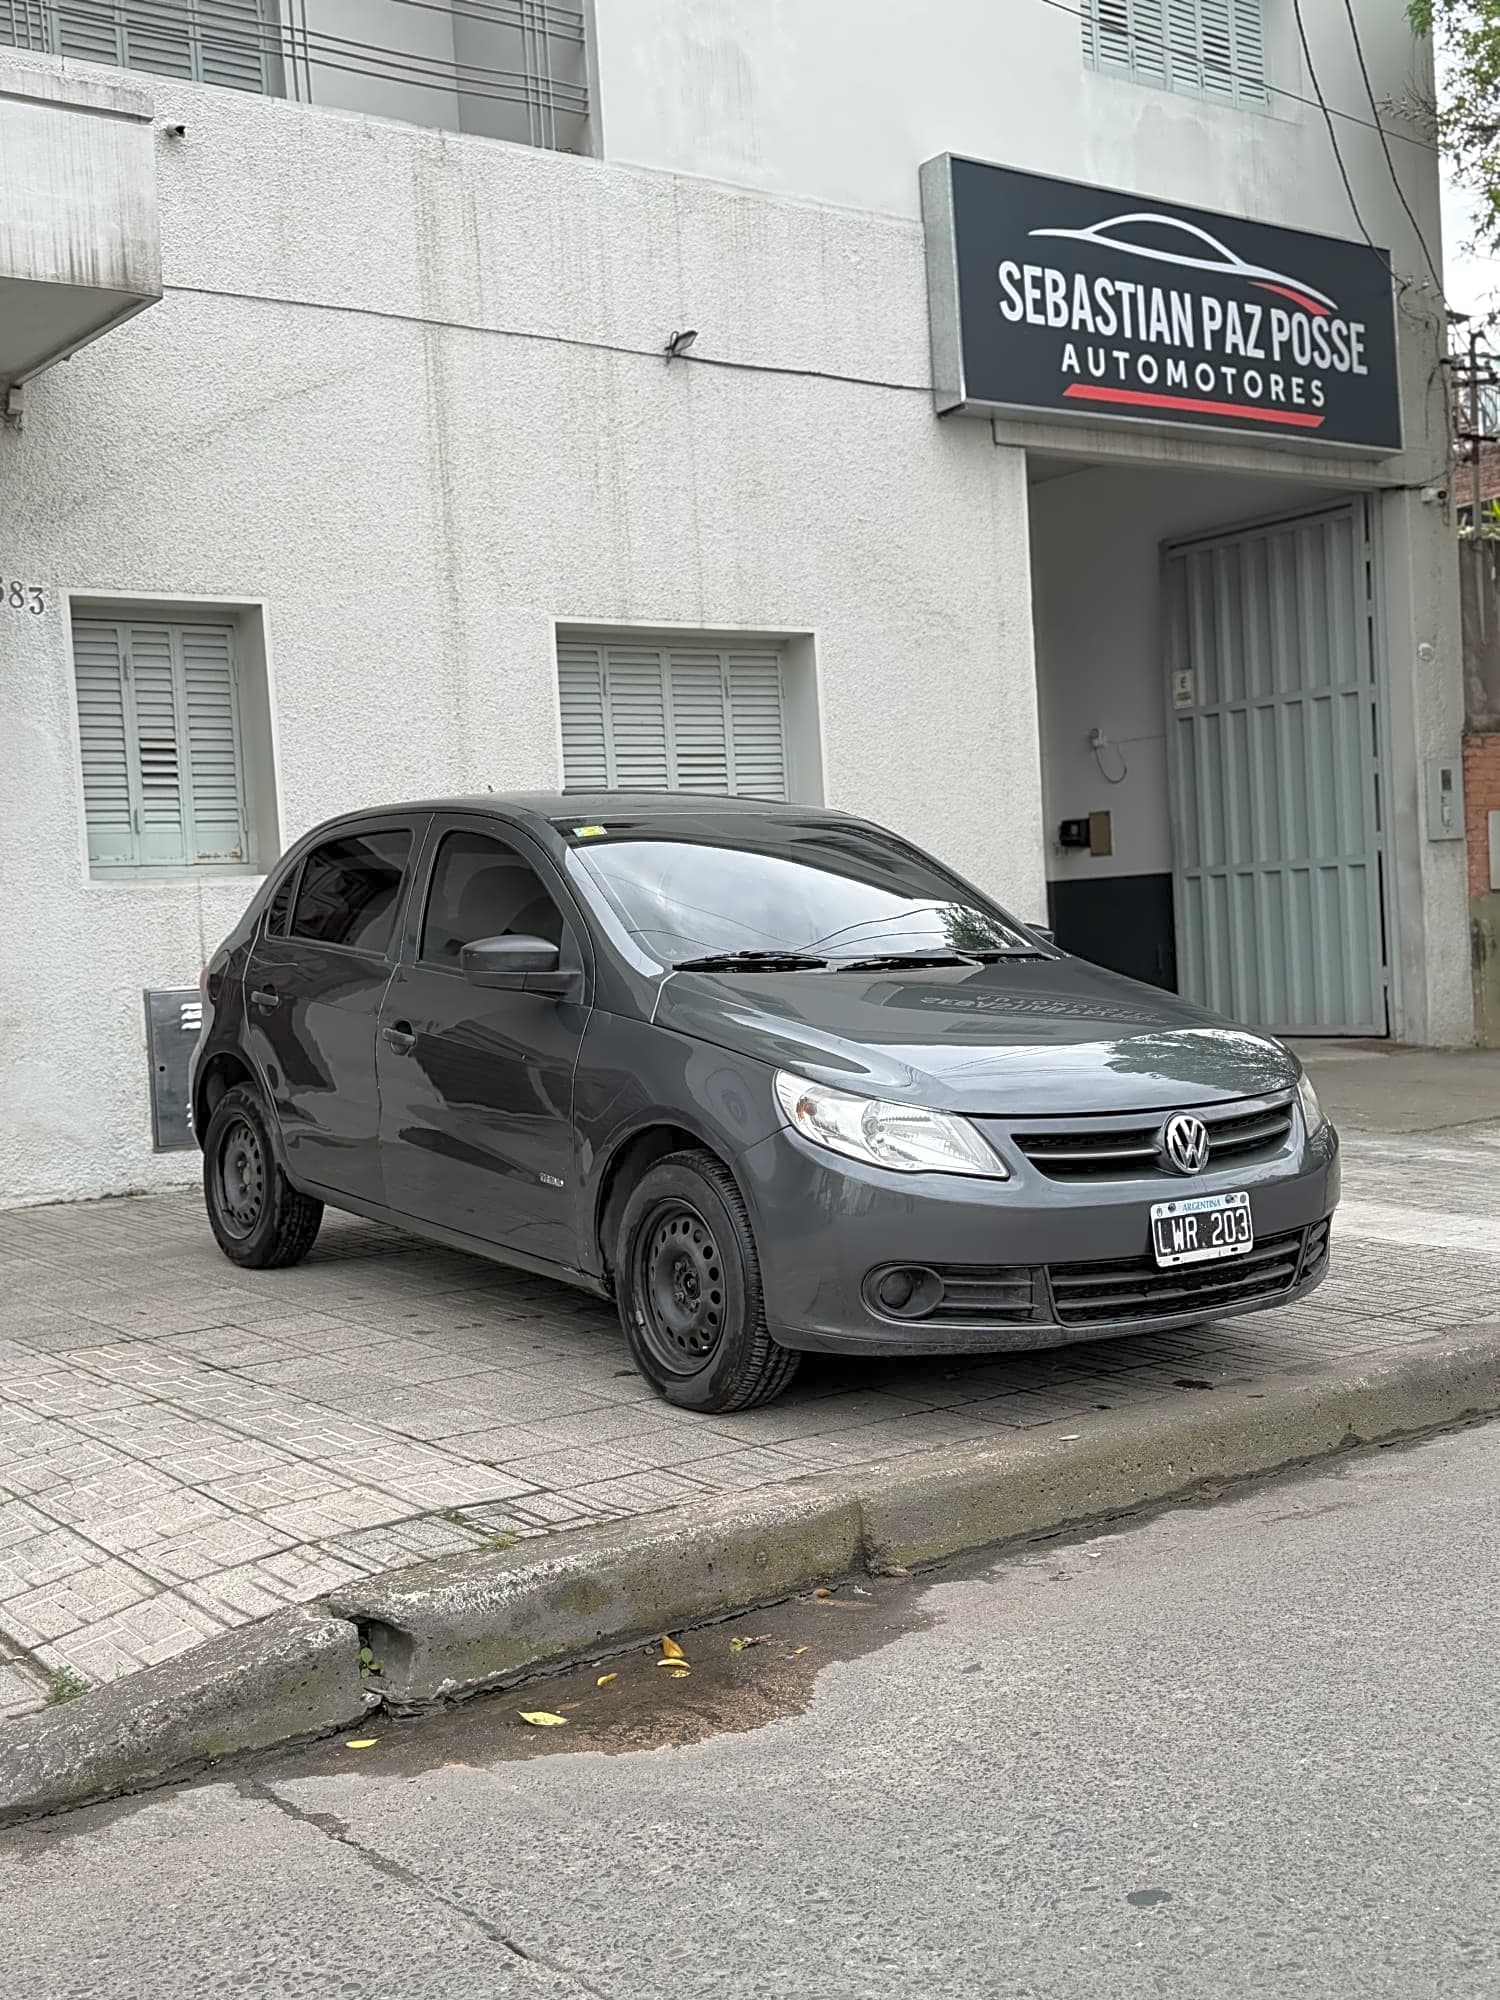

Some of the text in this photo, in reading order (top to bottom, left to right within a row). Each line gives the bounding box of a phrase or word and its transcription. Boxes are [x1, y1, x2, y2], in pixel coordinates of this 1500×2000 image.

[999, 260, 1368, 376] SEBASTIAN PAZ POSSE
[1061, 343, 1326, 408] AUTOMOTORES
[0, 575, 44, 615] 83
[1182, 1199, 1221, 1212] ARGENTINA
[1157, 1208, 1249, 1253] LWR 203
